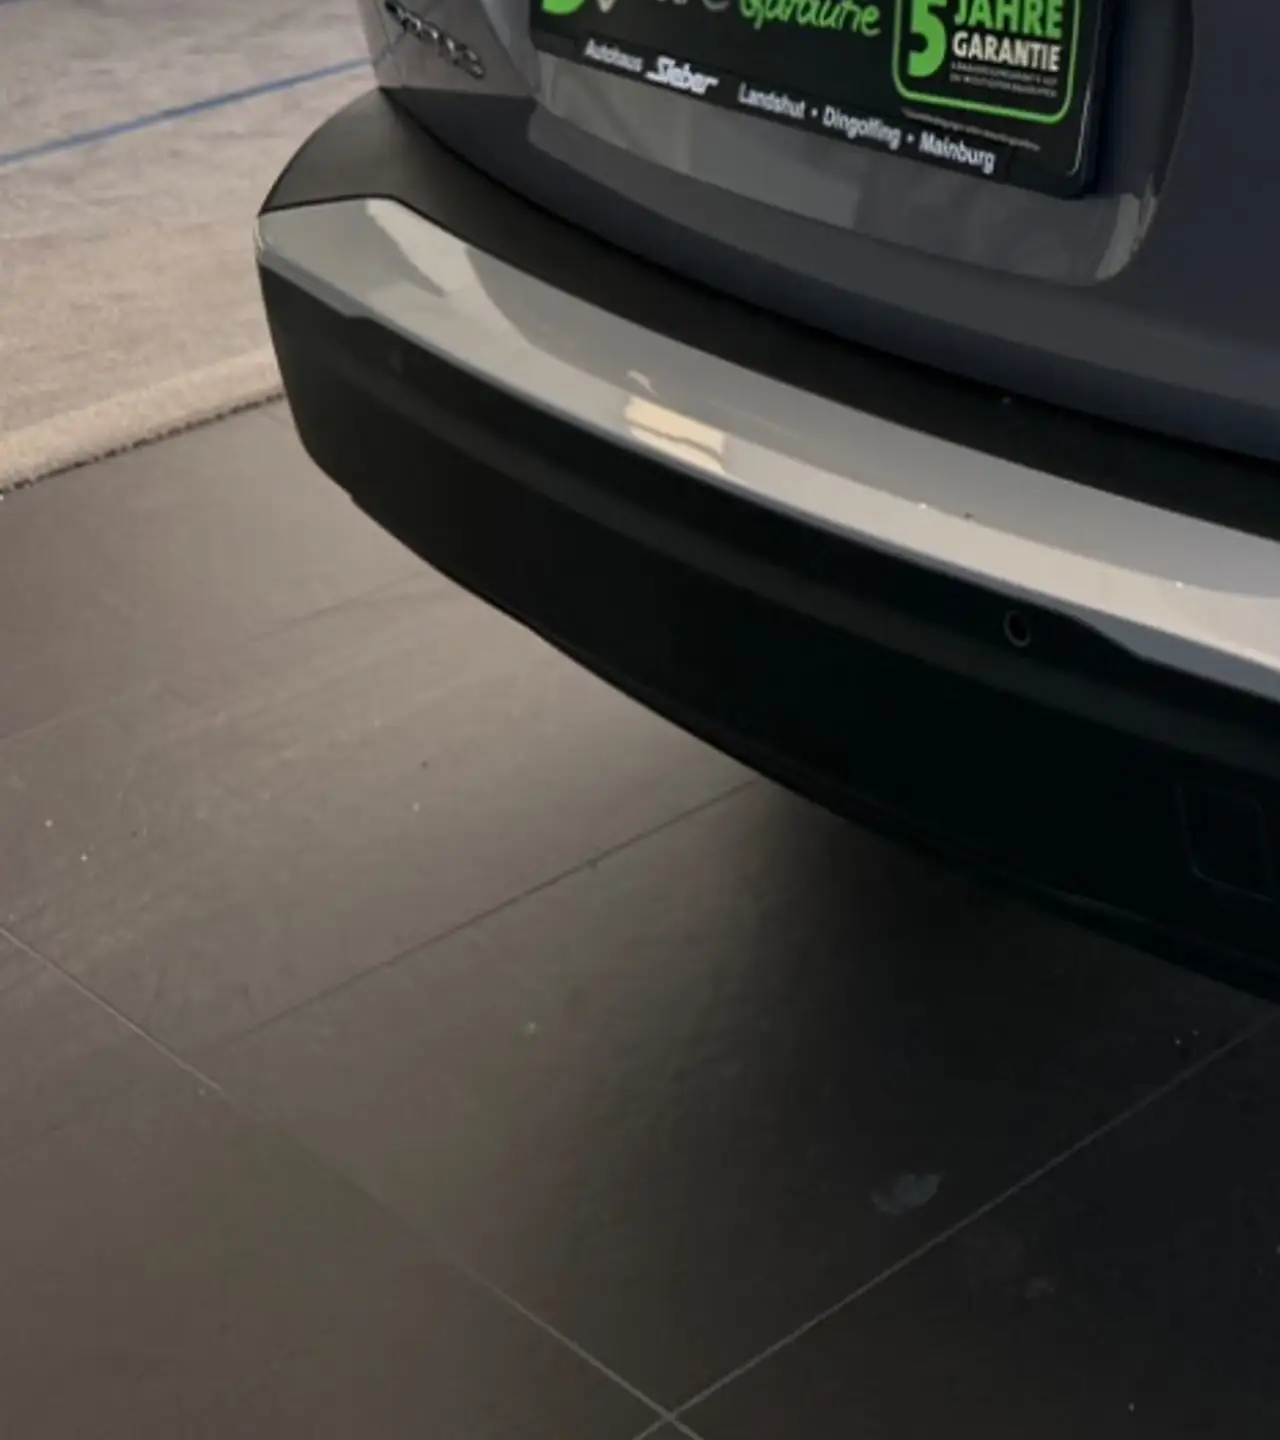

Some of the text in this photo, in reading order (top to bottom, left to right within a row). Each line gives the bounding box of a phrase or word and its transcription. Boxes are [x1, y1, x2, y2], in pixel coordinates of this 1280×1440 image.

[951, 29, 1063, 73] GARANTIE
[737, 81, 806, 120] Landshut
[822, 104, 902, 151] Dingolfing
[918, 130, 996, 175] Mainburg
